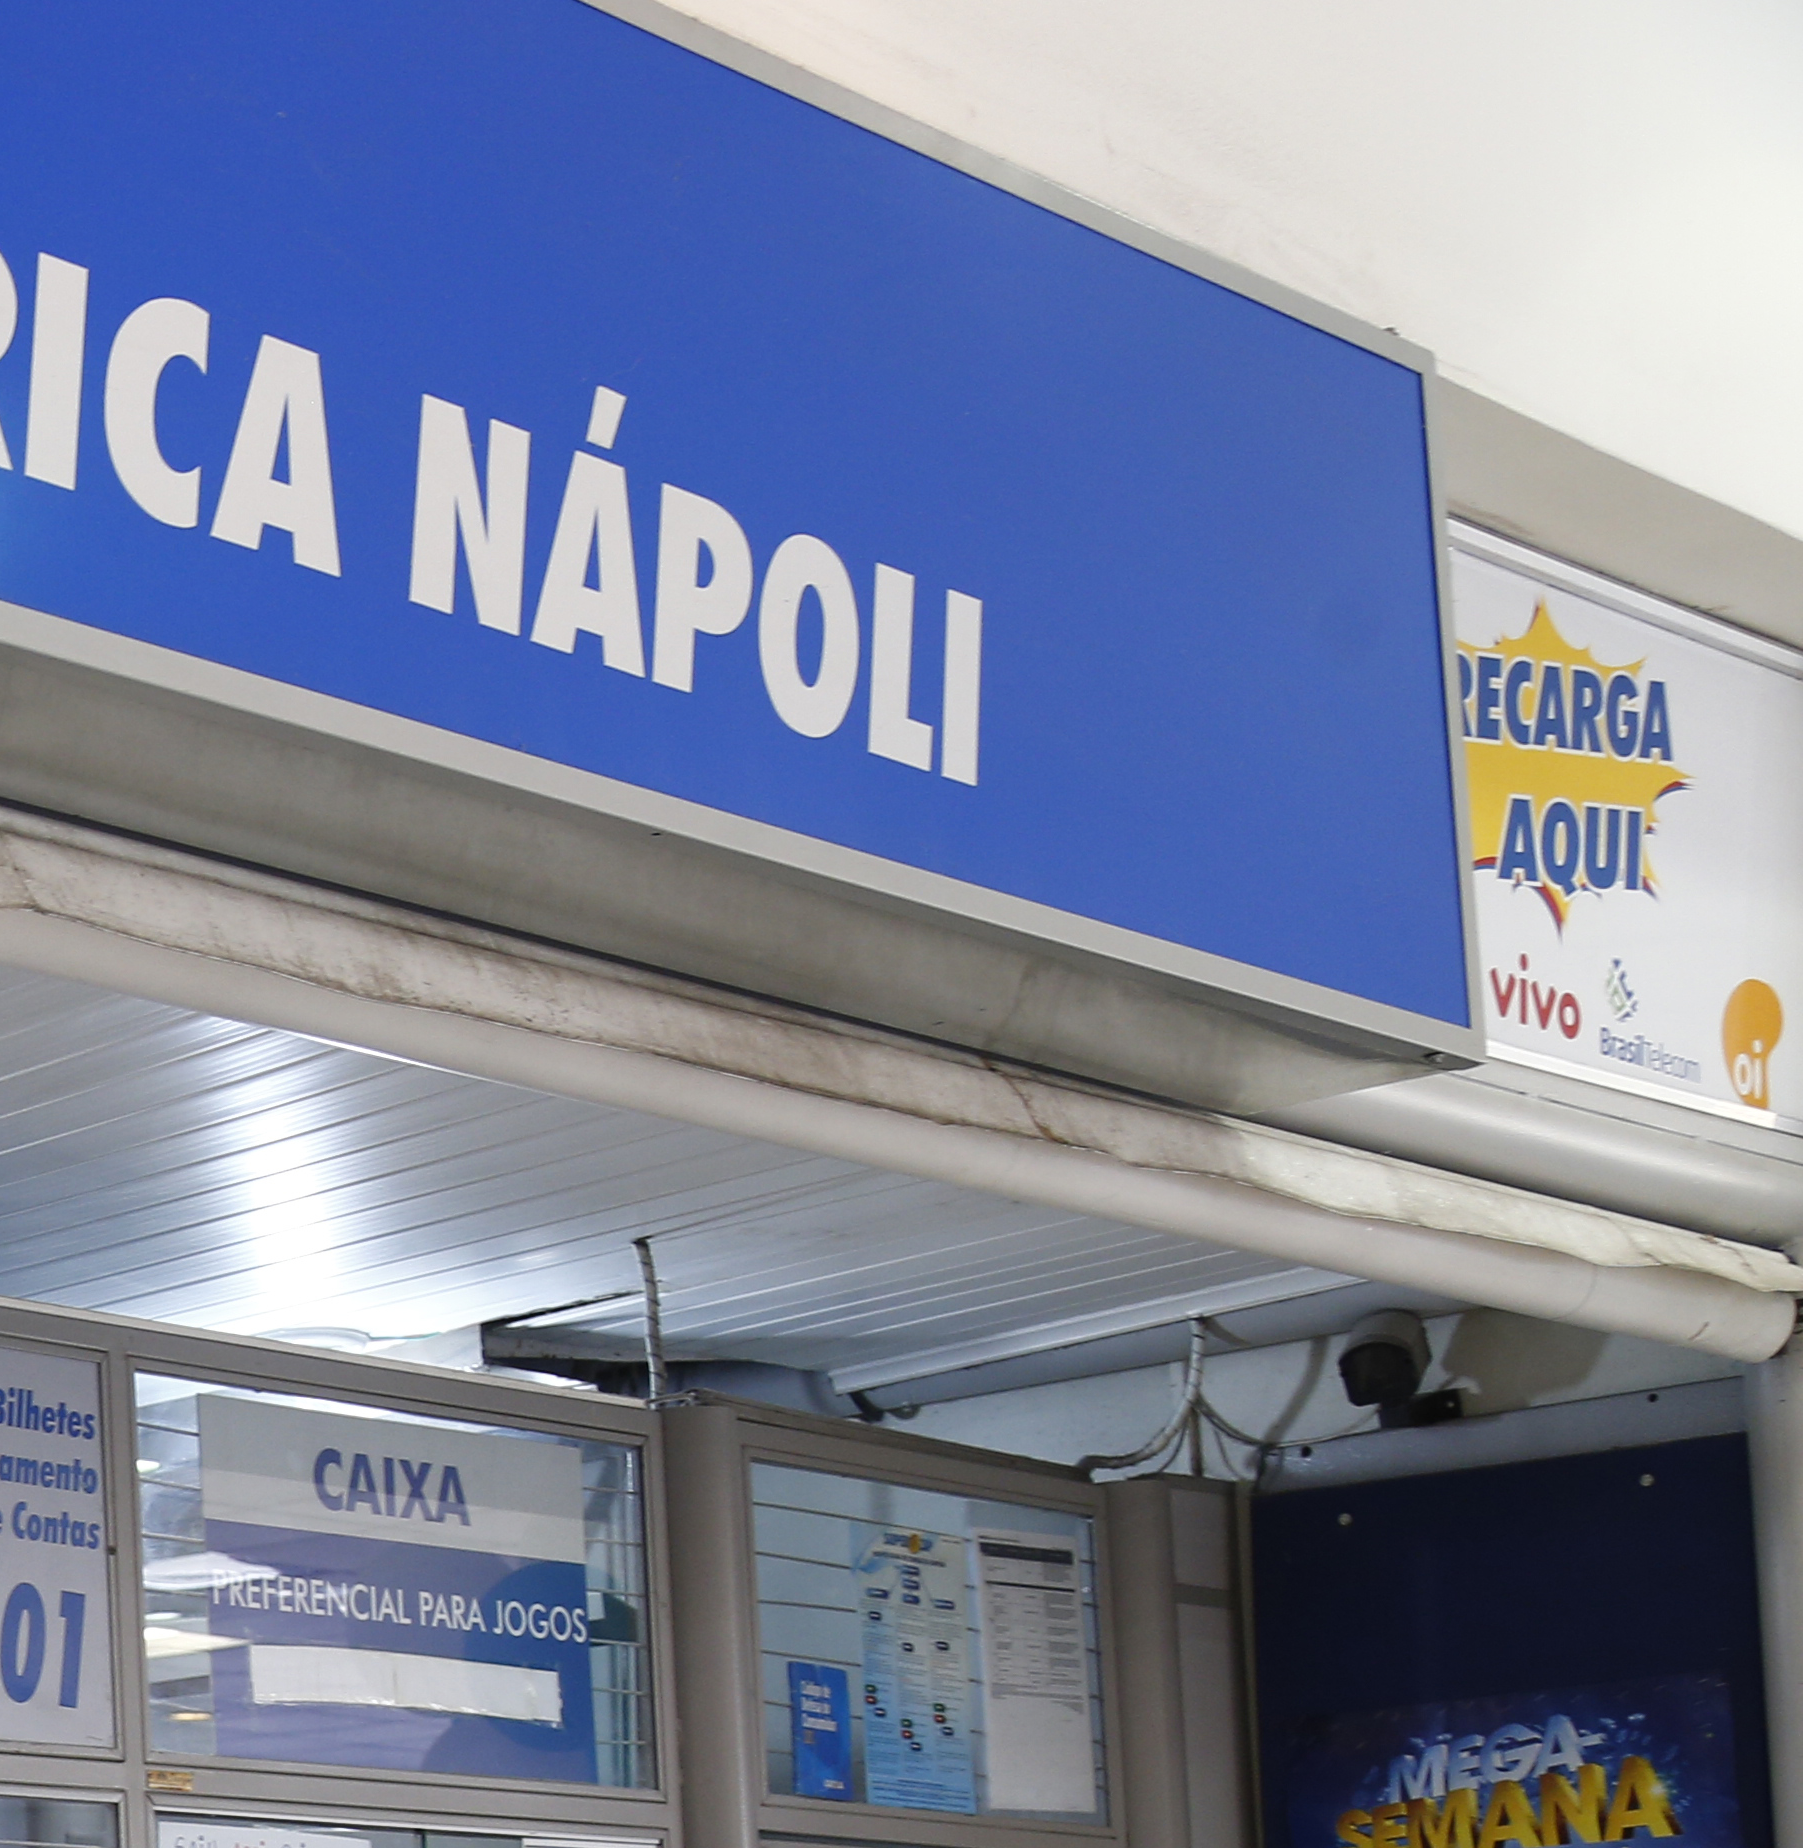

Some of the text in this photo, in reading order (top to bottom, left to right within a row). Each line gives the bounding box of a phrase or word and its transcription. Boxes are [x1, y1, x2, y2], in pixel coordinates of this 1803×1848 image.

[409, 386, 983, 787] NÁPOLI
[1498, 797, 1644, 899] AQUI
[1490, 954, 1581, 1039] vivo
[1733, 1039, 1763, 1099] oi
[12, 1502, 100, 1550] Contas
[313, 1448, 471, 1527] CAIXA
[0, 1582, 86, 1708] 01
[212, 1568, 587, 1643] PREFERENCIAL PARA JOGOS
[1389, 1713, 1605, 1803] MEGA-
